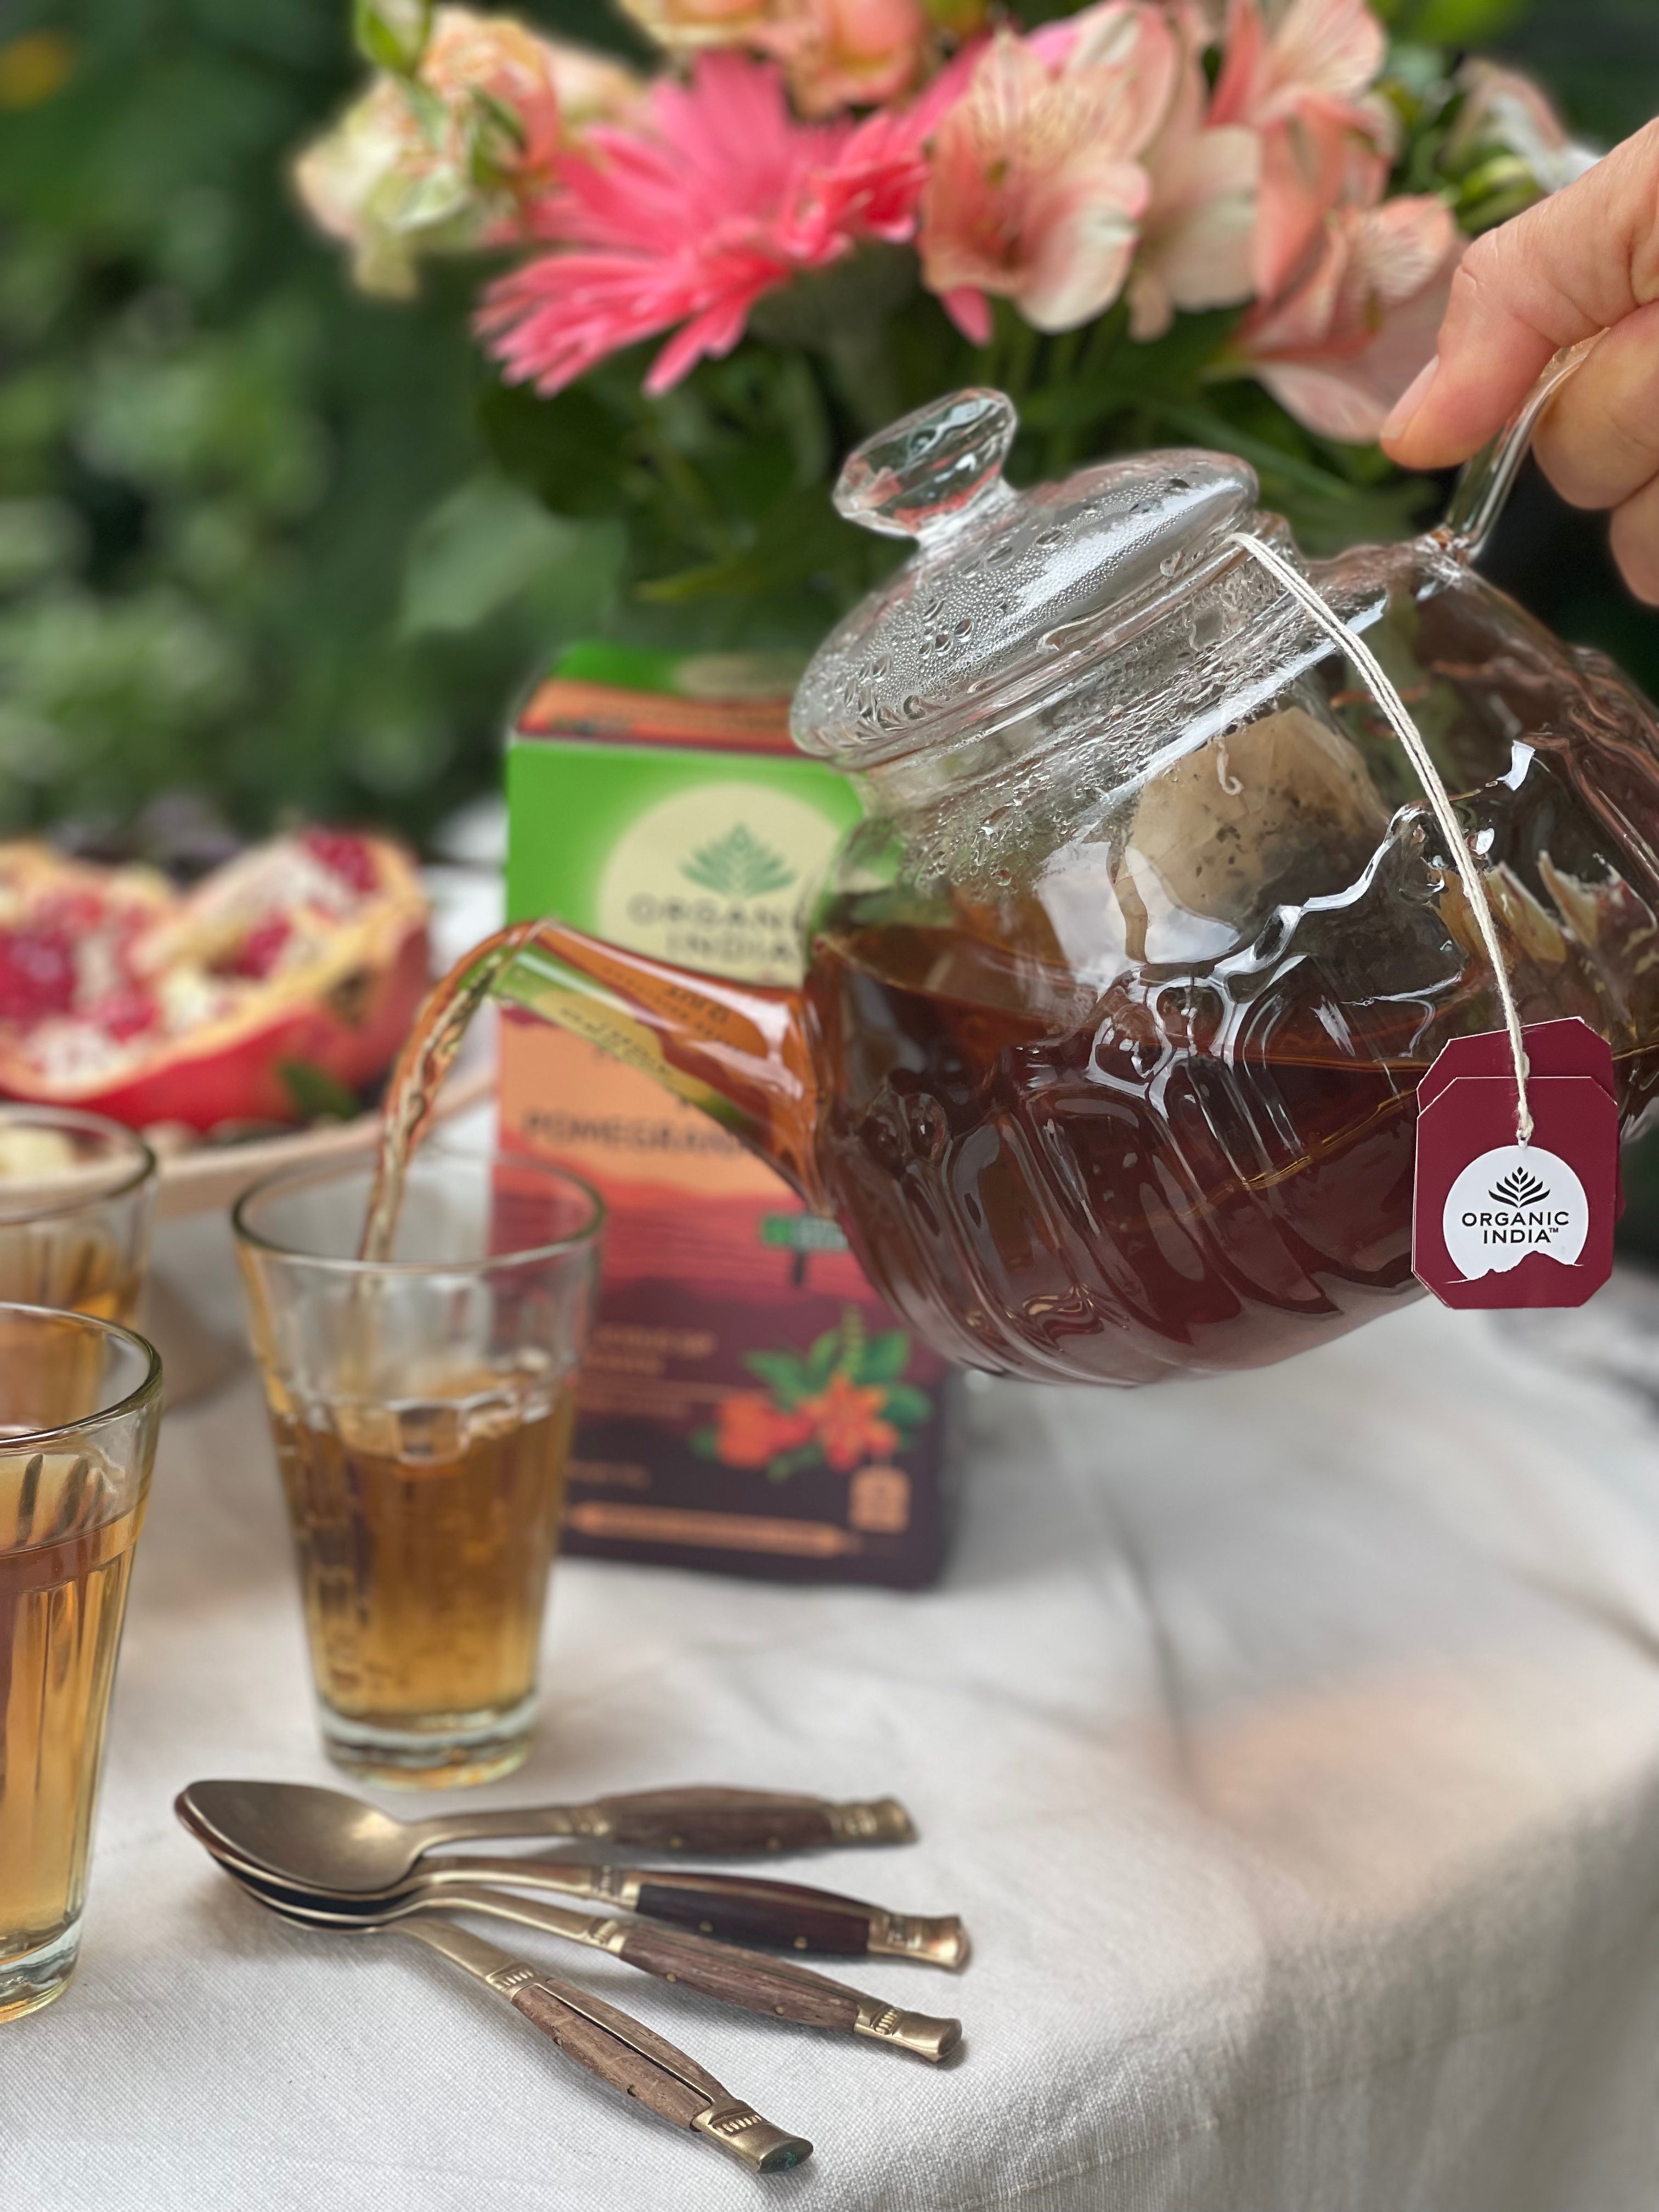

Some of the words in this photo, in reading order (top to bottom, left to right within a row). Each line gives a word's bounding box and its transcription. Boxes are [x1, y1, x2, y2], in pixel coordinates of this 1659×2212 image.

[626, 891, 801, 930] ORGANI
[522, 1107, 744, 1153] POMEGRAN
[1462, 1211, 1570, 1227] ORGANIC
